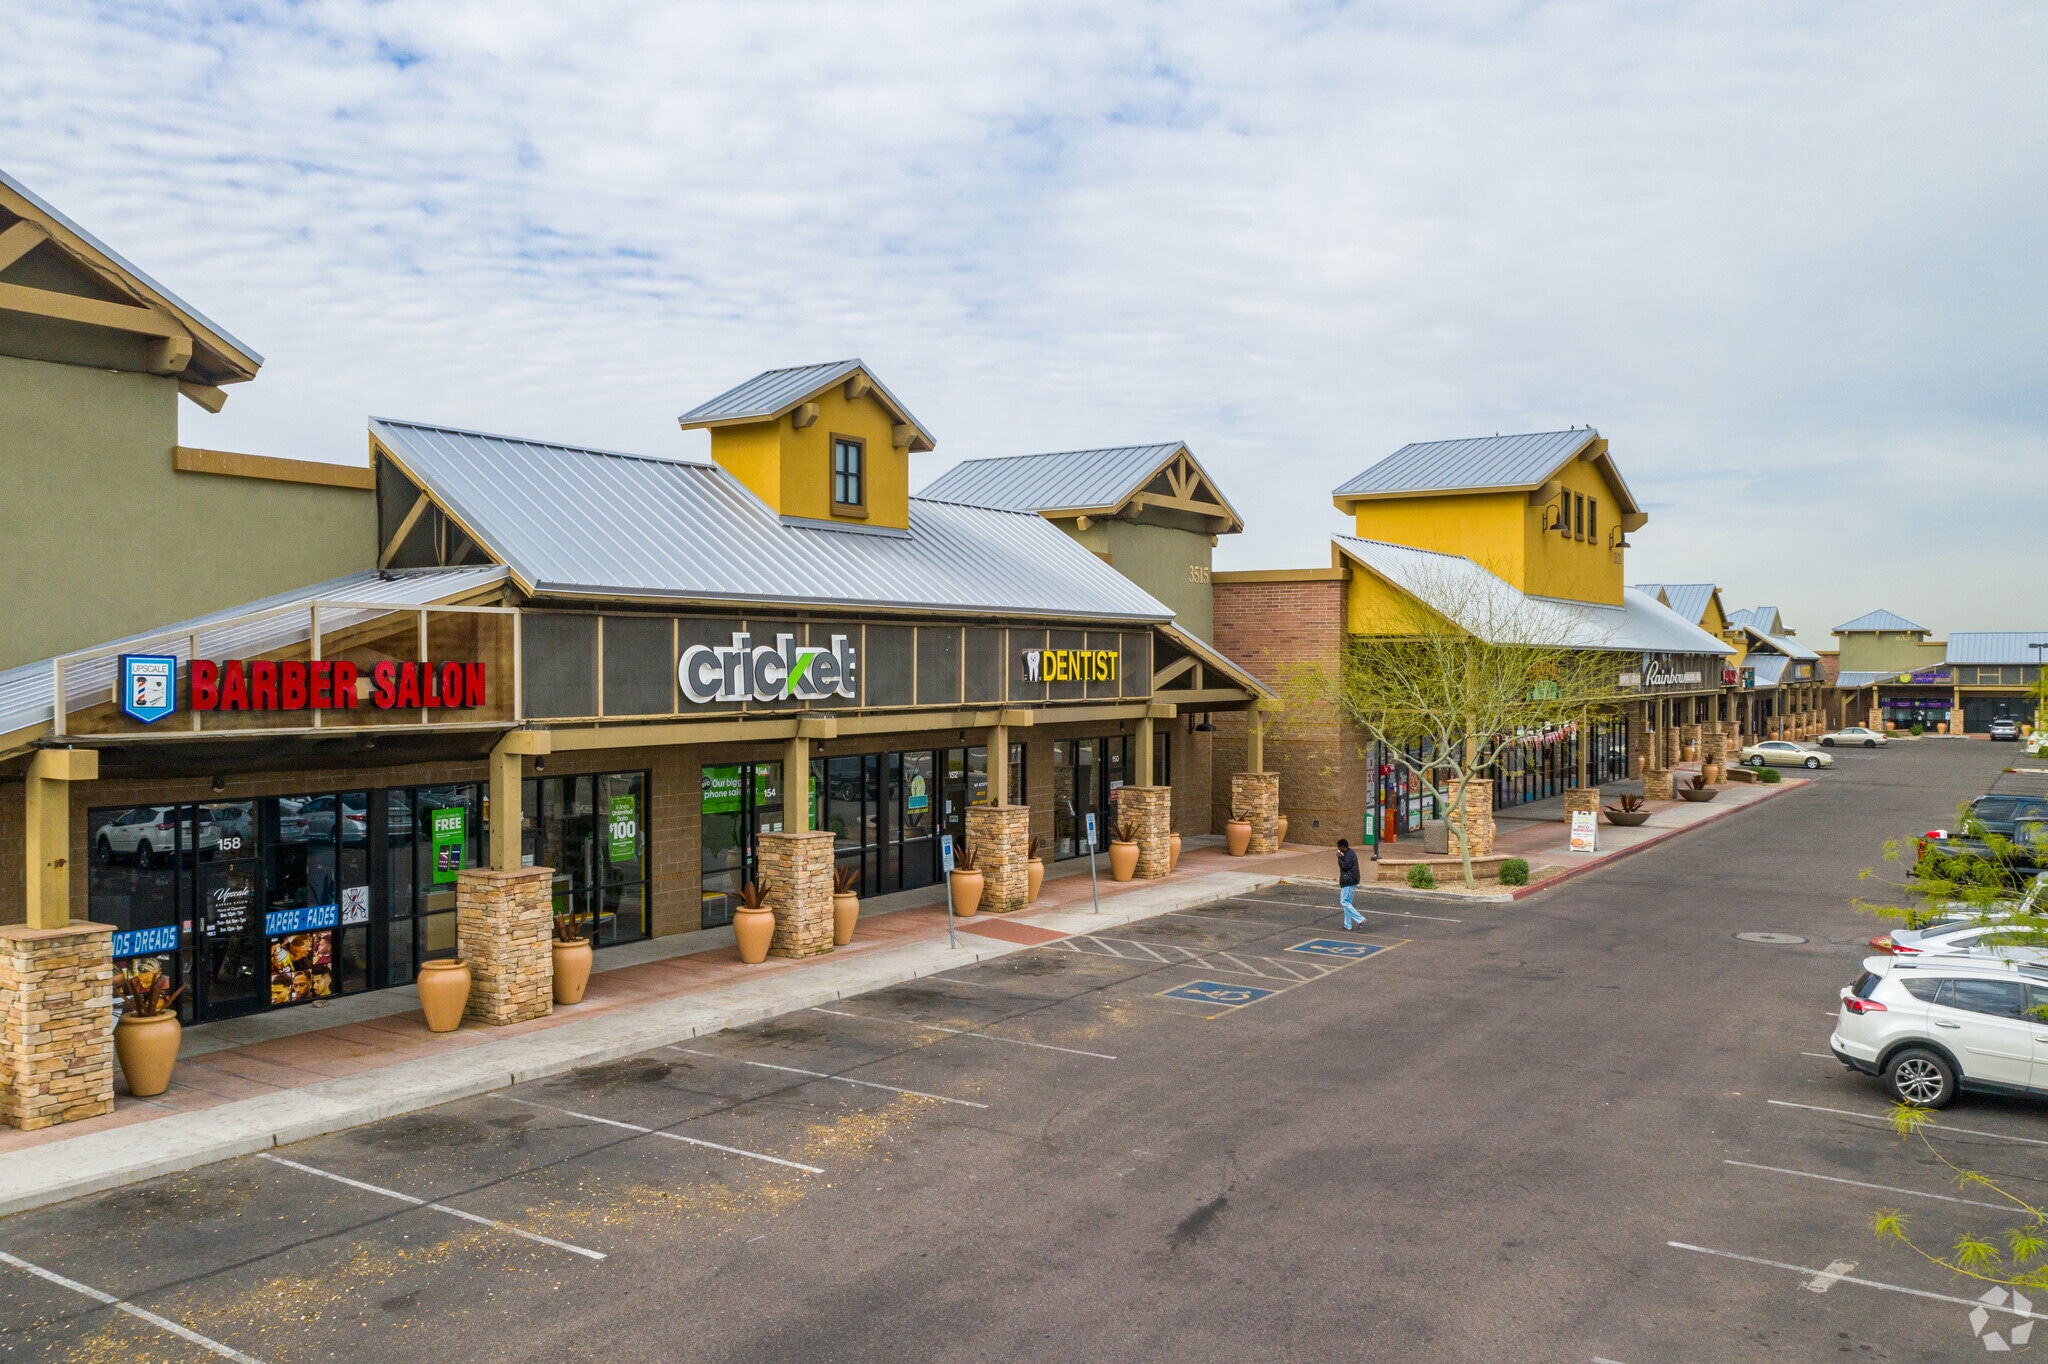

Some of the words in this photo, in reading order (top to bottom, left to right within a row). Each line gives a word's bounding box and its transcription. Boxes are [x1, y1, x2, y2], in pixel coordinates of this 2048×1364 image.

[1189, 565, 1209, 584] 3515
[133, 665, 167, 673] UPSCALE
[679, 632, 856, 703] cricket
[1043, 650, 1119, 681] DENTIST
[1646, 660, 1687, 686] Rainbow
[187, 660, 358, 711] BARBER
[369, 660, 486, 708] SALON
[712, 779, 725, 788] Our
[949, 771, 958, 779] 152
[704, 789, 728, 800] phone
[764, 788, 776, 798] 154
[435, 817, 462, 832] FREE
[609, 820, 636, 840] $100
[217, 837, 241, 851] 158
[266, 910, 300, 934] TAPERS
[306, 906, 336, 928] FADES
[134, 927, 176, 953] DREADS
